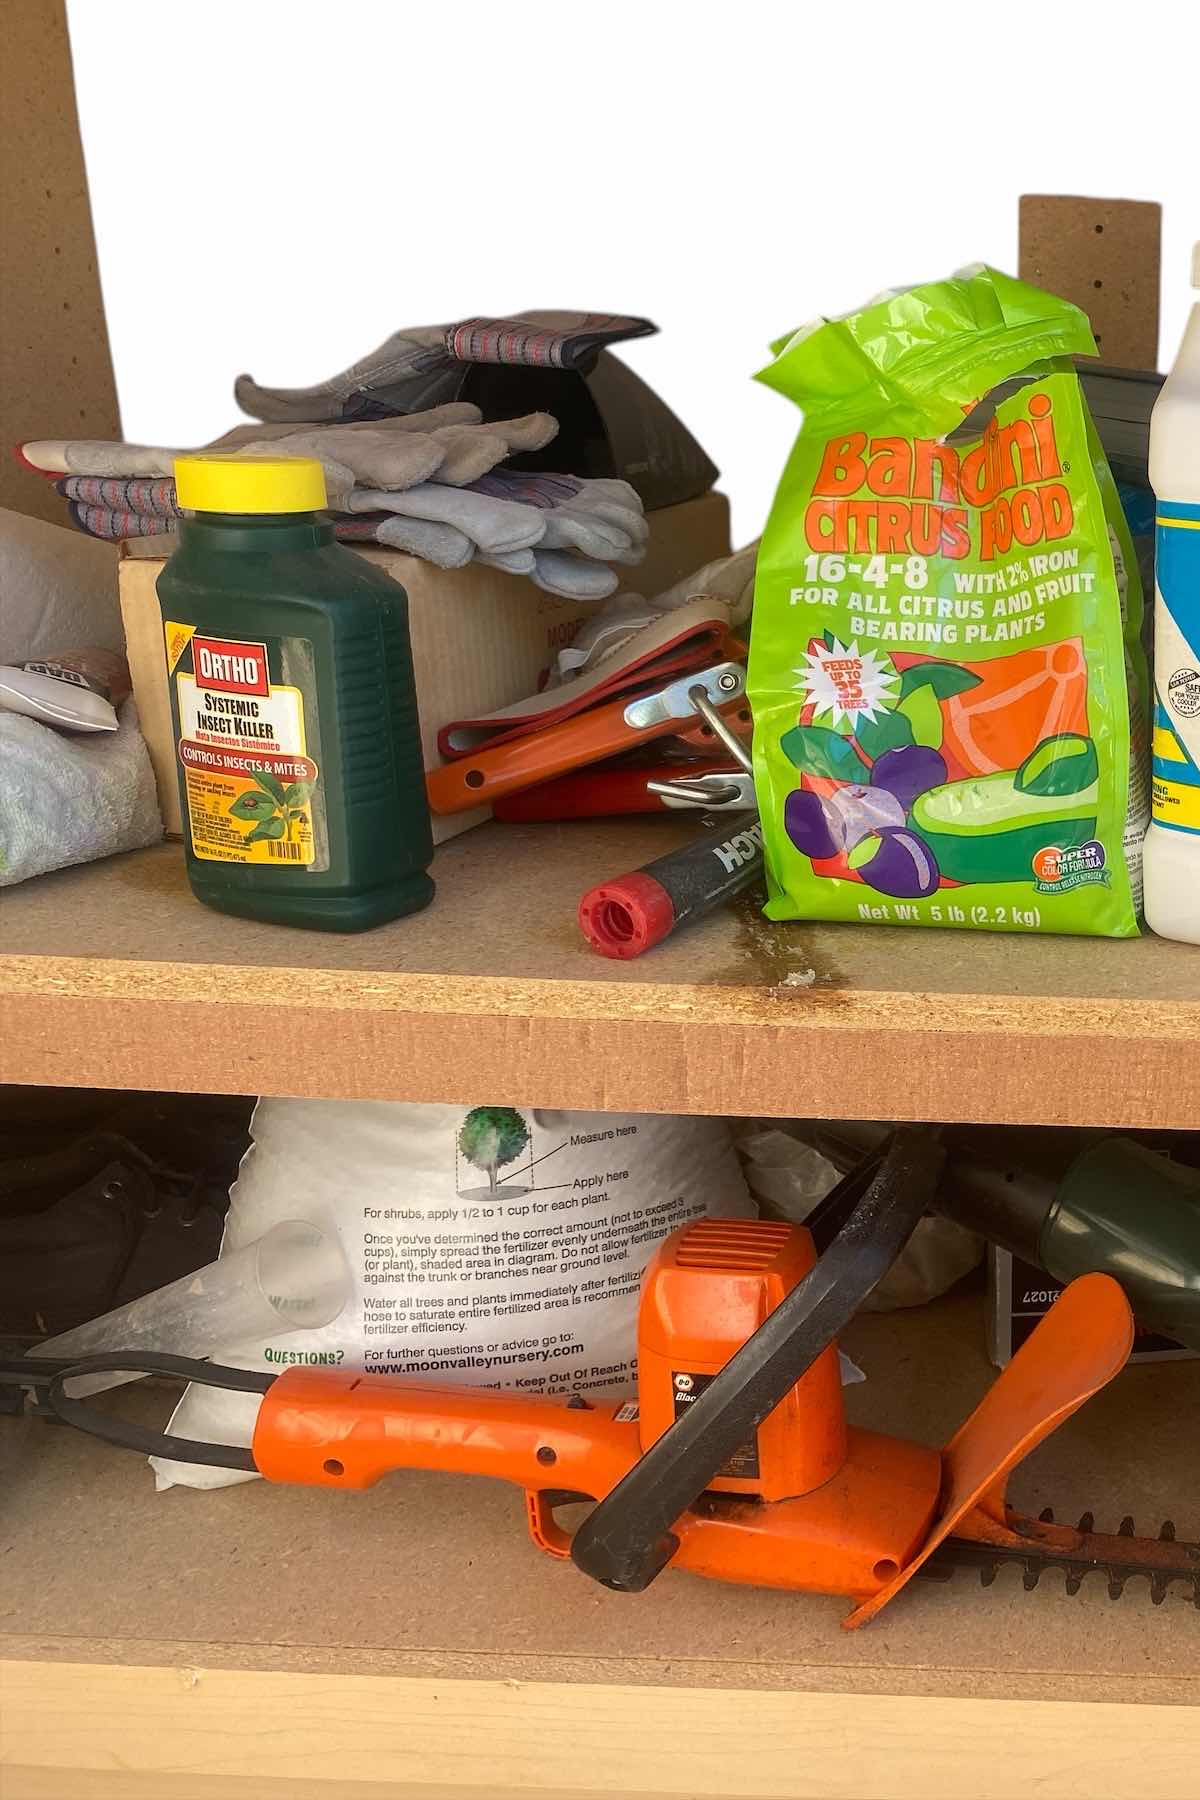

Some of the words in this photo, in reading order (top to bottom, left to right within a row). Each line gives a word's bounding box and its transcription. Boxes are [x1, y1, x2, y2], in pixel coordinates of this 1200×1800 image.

[805, 501, 971, 559] CITRUS
[803, 554, 928, 589] 16-4-8
[952, 571, 1005, 594] WITH
[1008, 562, 1028, 588] 2%
[1030, 550, 1078, 580] IRON
[790, 588, 839, 606] FOR
[848, 592, 891, 616] ALL
[900, 596, 984, 619] CITRUS
[992, 590, 1032, 617] AND
[1037, 572, 1096, 606] FRUIT
[851, 616, 957, 643] BEARING
[965, 613, 1045, 642] PLANTS
[200, 648, 259, 685] ORTHO
[822, 659, 863, 672] FEEDS
[845, 671, 861, 680] TO
[835, 681, 862, 698] 35
[205, 693, 259, 717] SYSTEMIC
[837, 700, 868, 709] TREES
[197, 711, 231, 735] INSECT
[234, 719, 274, 739] KILLER
[183, 747, 223, 768] CONTROLS
[224, 756, 263, 771] INSECTS
[265, 764, 272, 773] &
[275, 763, 307, 776] MITES
[1042, 864, 1068, 875] COLOR
[1069, 856, 1101, 872] FORMULA
[1044, 848, 1096, 864] SUPER
[859, 904, 889, 920] Net
[896, 906, 919, 921] Wt
[931, 907, 942, 921] 5
[949, 906, 965, 922] lb
[971, 907, 1009, 924] (2.2
[1012, 908, 1041, 926] kg)
[570, 1130, 614, 1146] Measure
[616, 1125, 637, 1137] here
[573, 1175, 604, 1190] Apply
[607, 1170, 629, 1182] here
[364, 1208, 381, 1218] For
[384, 1208, 424, 1220] shrubs,
[428, 1210, 458, 1220] apply
[463, 1208, 479, 1218] 1/2
[483, 1208, 494, 1217] to
[497, 1207, 503, 1216] 1
[507, 1207, 529, 1216] cup
[533, 1203, 549, 1213] for
[552, 1199, 579, 1211] each
[581, 1193, 611, 1207] plant.
[364, 1233, 393, 1244] Once
[397, 1234, 431, 1246] you've
[434, 1232, 498, 1244] determined
[502, 1232, 520, 1240] the
[524, 1226, 563, 1239] correct
[567, 1218, 608, 1232] amount
[611, 1215, 631, 1226] (not
[633, 1211, 643, 1219] to
[645, 1202, 677, 1216] exceed
[364, 1298, 396, 1308] Water
[400, 1298, 412, 1308] all
[416, 1297, 444, 1307] trees
[447, 1296, 468, 1306] and
[473, 1294, 507, 1306] plants
[511, 1284, 578, 1301] immediately
[581, 1279, 605, 1291] after
[364, 1312, 391, 1322] hose
[395, 1312, 406, 1321] to
[410, 1310, 455, 1320] saturate
[458, 1308, 490, 1318] entire
[494, 1301, 540, 1316] fertilized
[544, 1297, 569, 1310] area
[572, 1296, 581, 1305] is
[364, 1323, 407, 1334] fertilizer
[411, 1322, 467, 1333] efficiency.
[265, 1348, 344, 1365] QUESTIONS?
[365, 1350, 383, 1360] For
[387, 1348, 424, 1359] further
[428, 1343, 484, 1357] questions
[487, 1343, 499, 1352] or
[502, 1339, 539, 1350] advice
[543, 1336, 557, 1346] go
[560, 1332, 574, 1342] to:
[365, 1344, 584, 1374] www.moonvalleynursery.com
[515, 1377, 545, 1389] Keep
[550, 1373, 570, 1383] Out
[575, 1369, 588, 1380] Of
[591, 1363, 627, 1377] Reach
[573, 1376, 628, 1391] Concrete,
